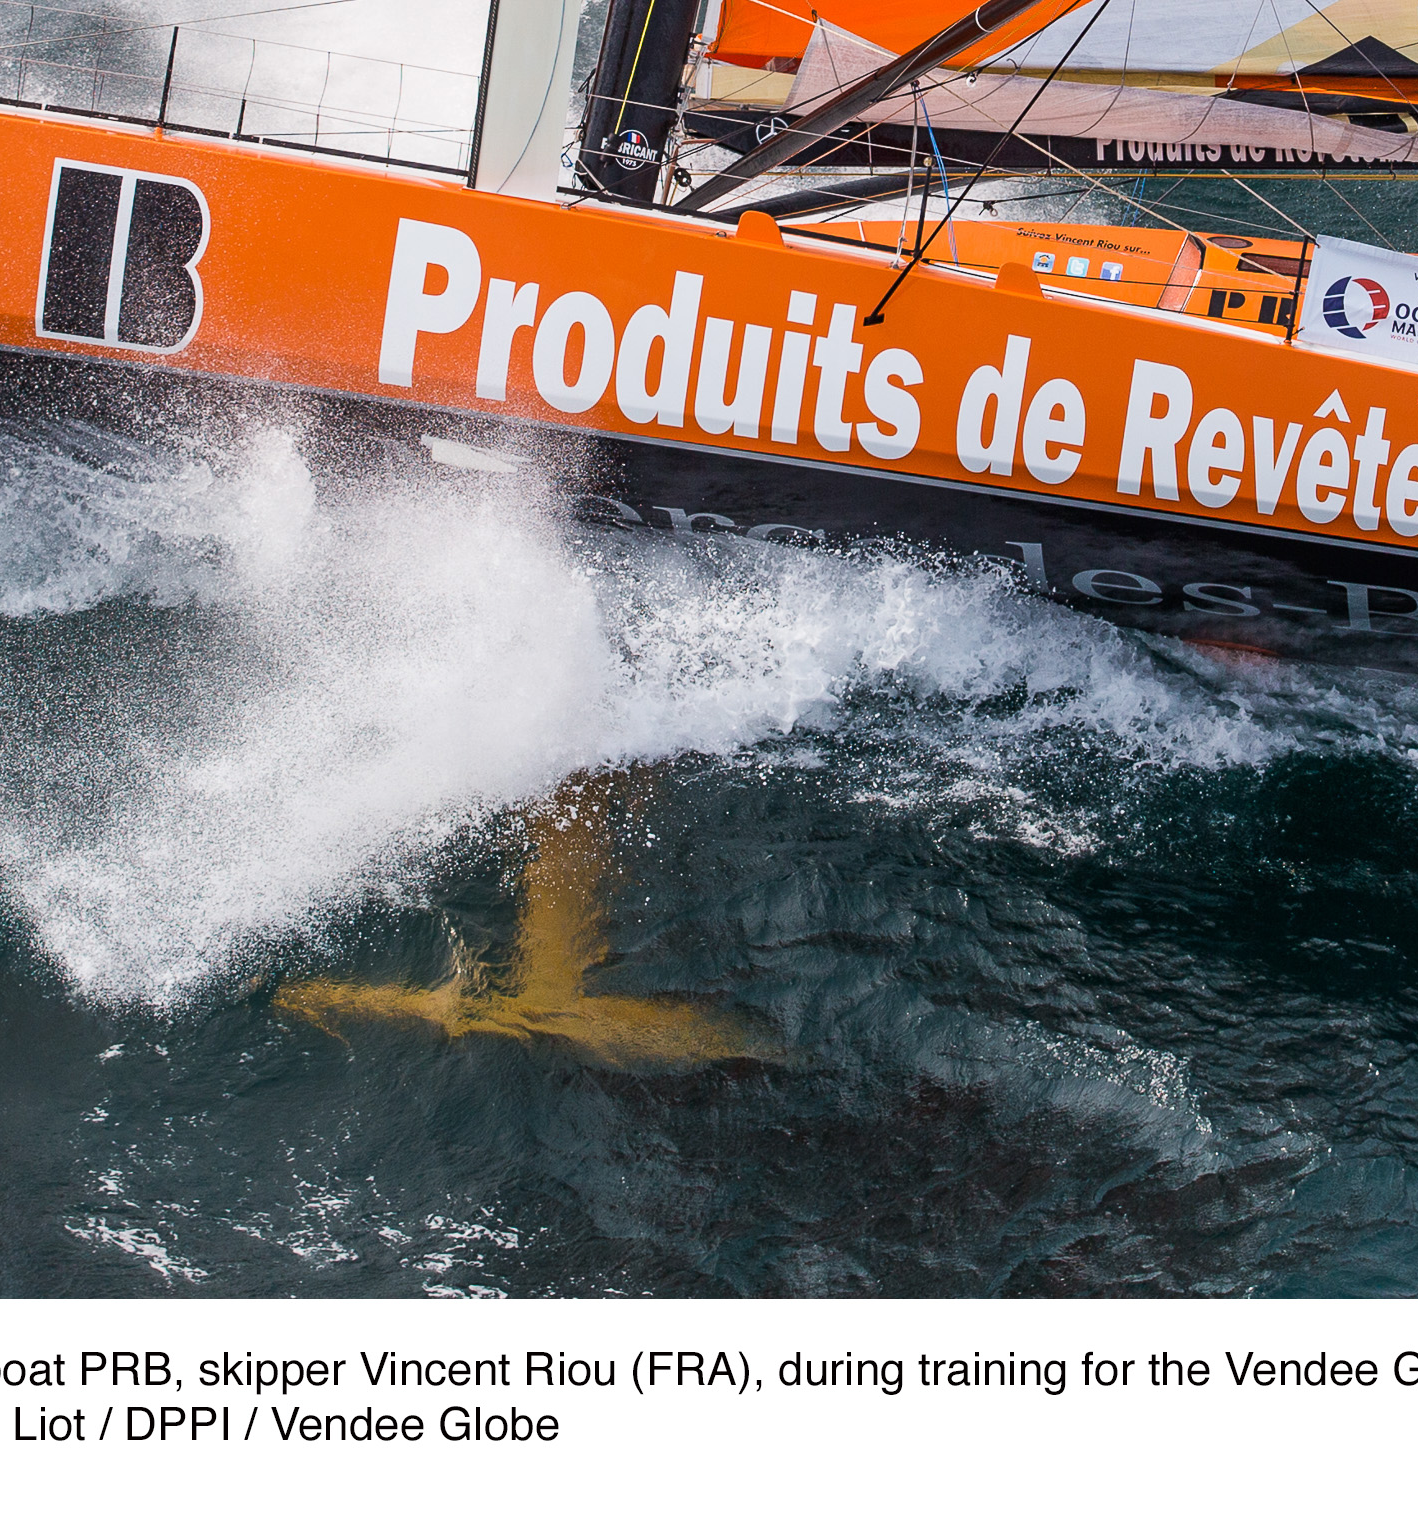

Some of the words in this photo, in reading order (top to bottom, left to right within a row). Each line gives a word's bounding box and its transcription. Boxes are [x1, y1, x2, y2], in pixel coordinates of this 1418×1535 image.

[1055, 233, 1094, 246] Vincent
[1097, 239, 1120, 251] Riou
[1390, 334, 1414, 343] WORLD
[378, 217, 923, 460] Produits
[956, 334, 1086, 485] de
